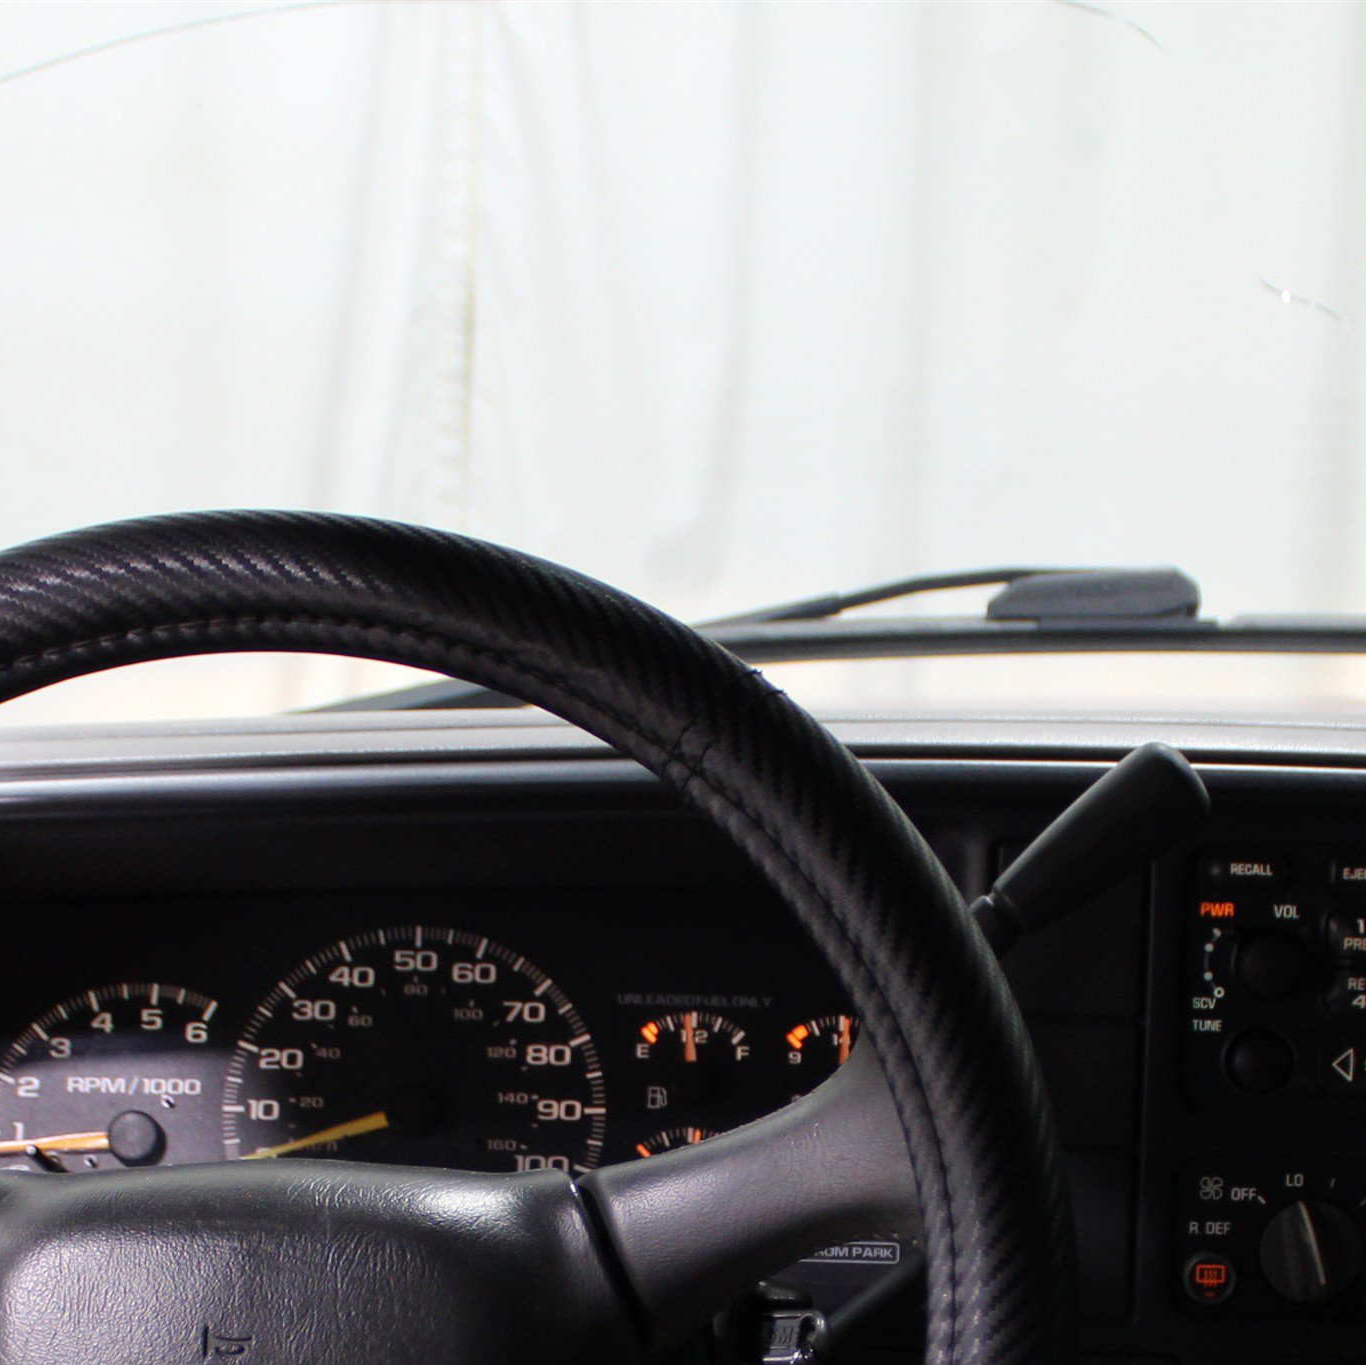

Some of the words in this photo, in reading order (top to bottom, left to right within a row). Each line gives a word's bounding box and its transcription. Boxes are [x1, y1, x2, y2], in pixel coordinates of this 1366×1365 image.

[1230, 862, 1274, 877] RECALL
[1200, 902, 1236, 918] PWR
[1273, 904, 1300, 920] VOL
[1356, 917, 1366, 934] 1
[393, 949, 438, 972] 50
[328, 966, 375, 988] 40
[451, 962, 497, 984] 60
[403, 984, 428, 996] 80
[291, 999, 337, 1021] 30
[1192, 995, 1217, 1010] SCV
[140, 1007, 164, 1030] 5
[502, 1000, 546, 1023] 70
[89, 1011, 114, 1034] 4
[348, 1015, 373, 1027] 60
[1192, 1019, 1223, 1033] TUNE
[184, 1021, 209, 1043] 6
[49, 1036, 72, 1059] 3
[315, 1047, 341, 1060] 40
[525, 1044, 572, 1066] 80
[635, 1042, 651, 1059] E
[734, 1045, 750, 1062] F
[258, 1048, 304, 1070] 20
[787, 1051, 803, 1065] 9
[15, 1076, 41, 1098] 2
[66, 1076, 202, 1096] RPM/1000
[299, 1096, 325, 1109] 20
[497, 1092, 528, 1104] 140
[247, 1098, 280, 1120] 10
[536, 1099, 582, 1121] 90
[13, 1121, 25, 1141] 1
[514, 1154, 570, 1172] 100
[1285, 1173, 1304, 1188] LO
[1230, 1187, 1258, 1201] OFF
[1188, 1220, 1203, 1235] R.
[1205, 1221, 1232, 1236] DEF
[852, 1246, 893, 1259] PARK
